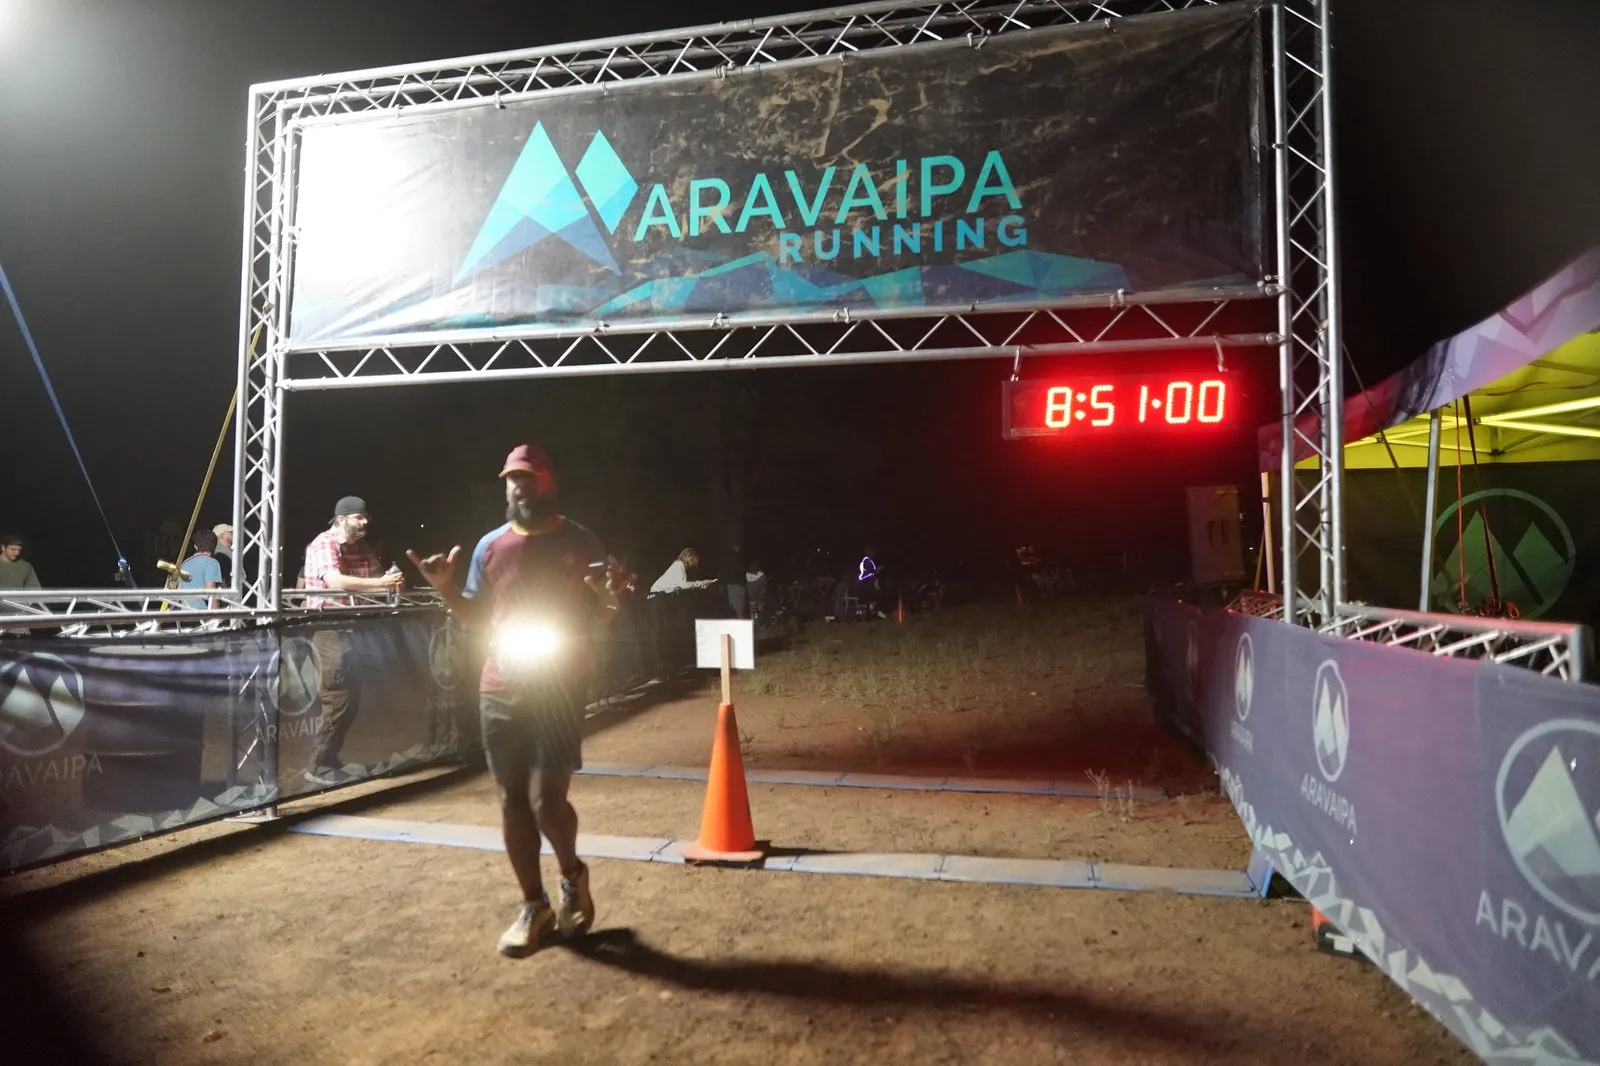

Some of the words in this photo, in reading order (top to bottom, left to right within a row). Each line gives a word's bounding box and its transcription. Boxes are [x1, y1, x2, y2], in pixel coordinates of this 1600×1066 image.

[634, 150, 1024, 242] ARAVAIPA
[779, 215, 1028, 264] RUNNING
[0, 751, 104, 790] AVAIPA
[1300, 773, 1357, 835] ARAVAIPA
